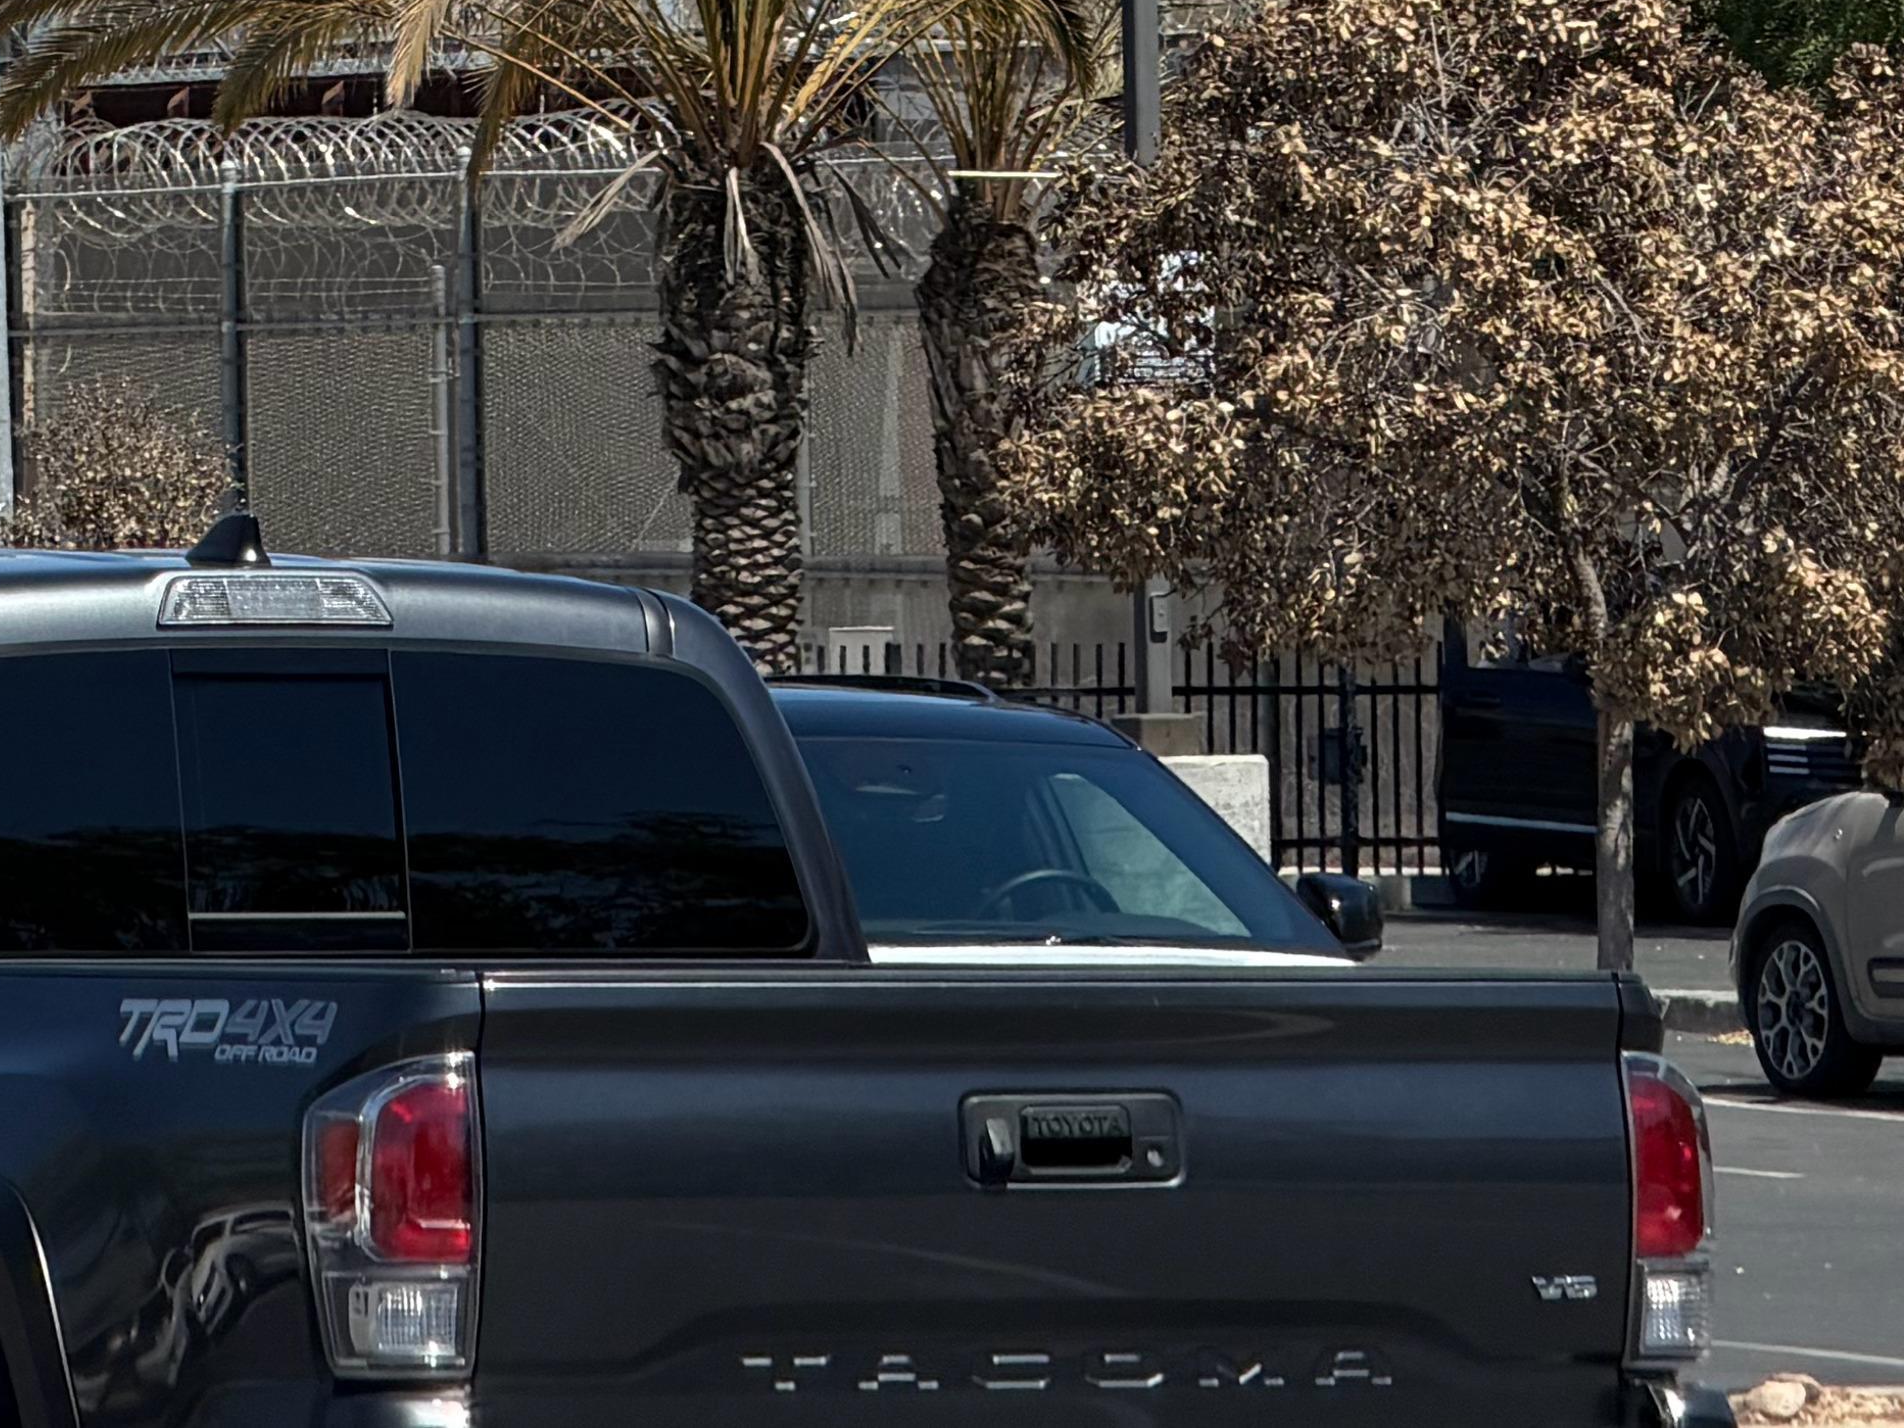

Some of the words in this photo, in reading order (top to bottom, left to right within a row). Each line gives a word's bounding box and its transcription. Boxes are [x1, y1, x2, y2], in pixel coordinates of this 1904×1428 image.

[214, 1044, 257, 1063] OFF
[257, 1046, 318, 1064] ROAD
[1032, 1114, 1125, 1136] TOYOTA
[740, 1347, 1394, 1391] TACOMA
